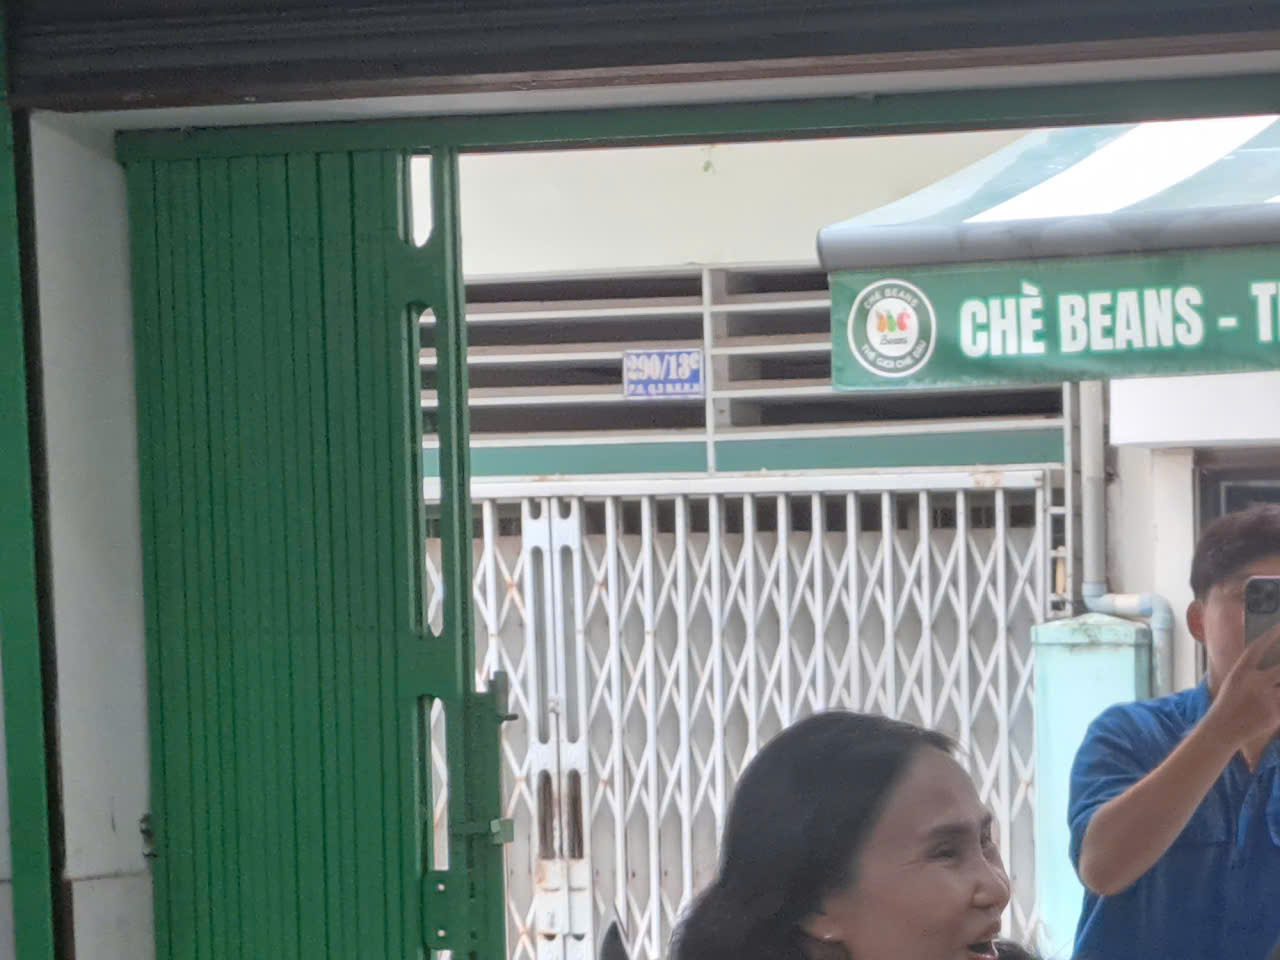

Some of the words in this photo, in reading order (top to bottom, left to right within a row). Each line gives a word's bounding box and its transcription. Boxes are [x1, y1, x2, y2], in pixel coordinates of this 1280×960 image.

[960, 280, 1046, 358] CHÈ
[1058, 287, 1204, 353] BEANS
[1218, 317, 1238, 328] -
